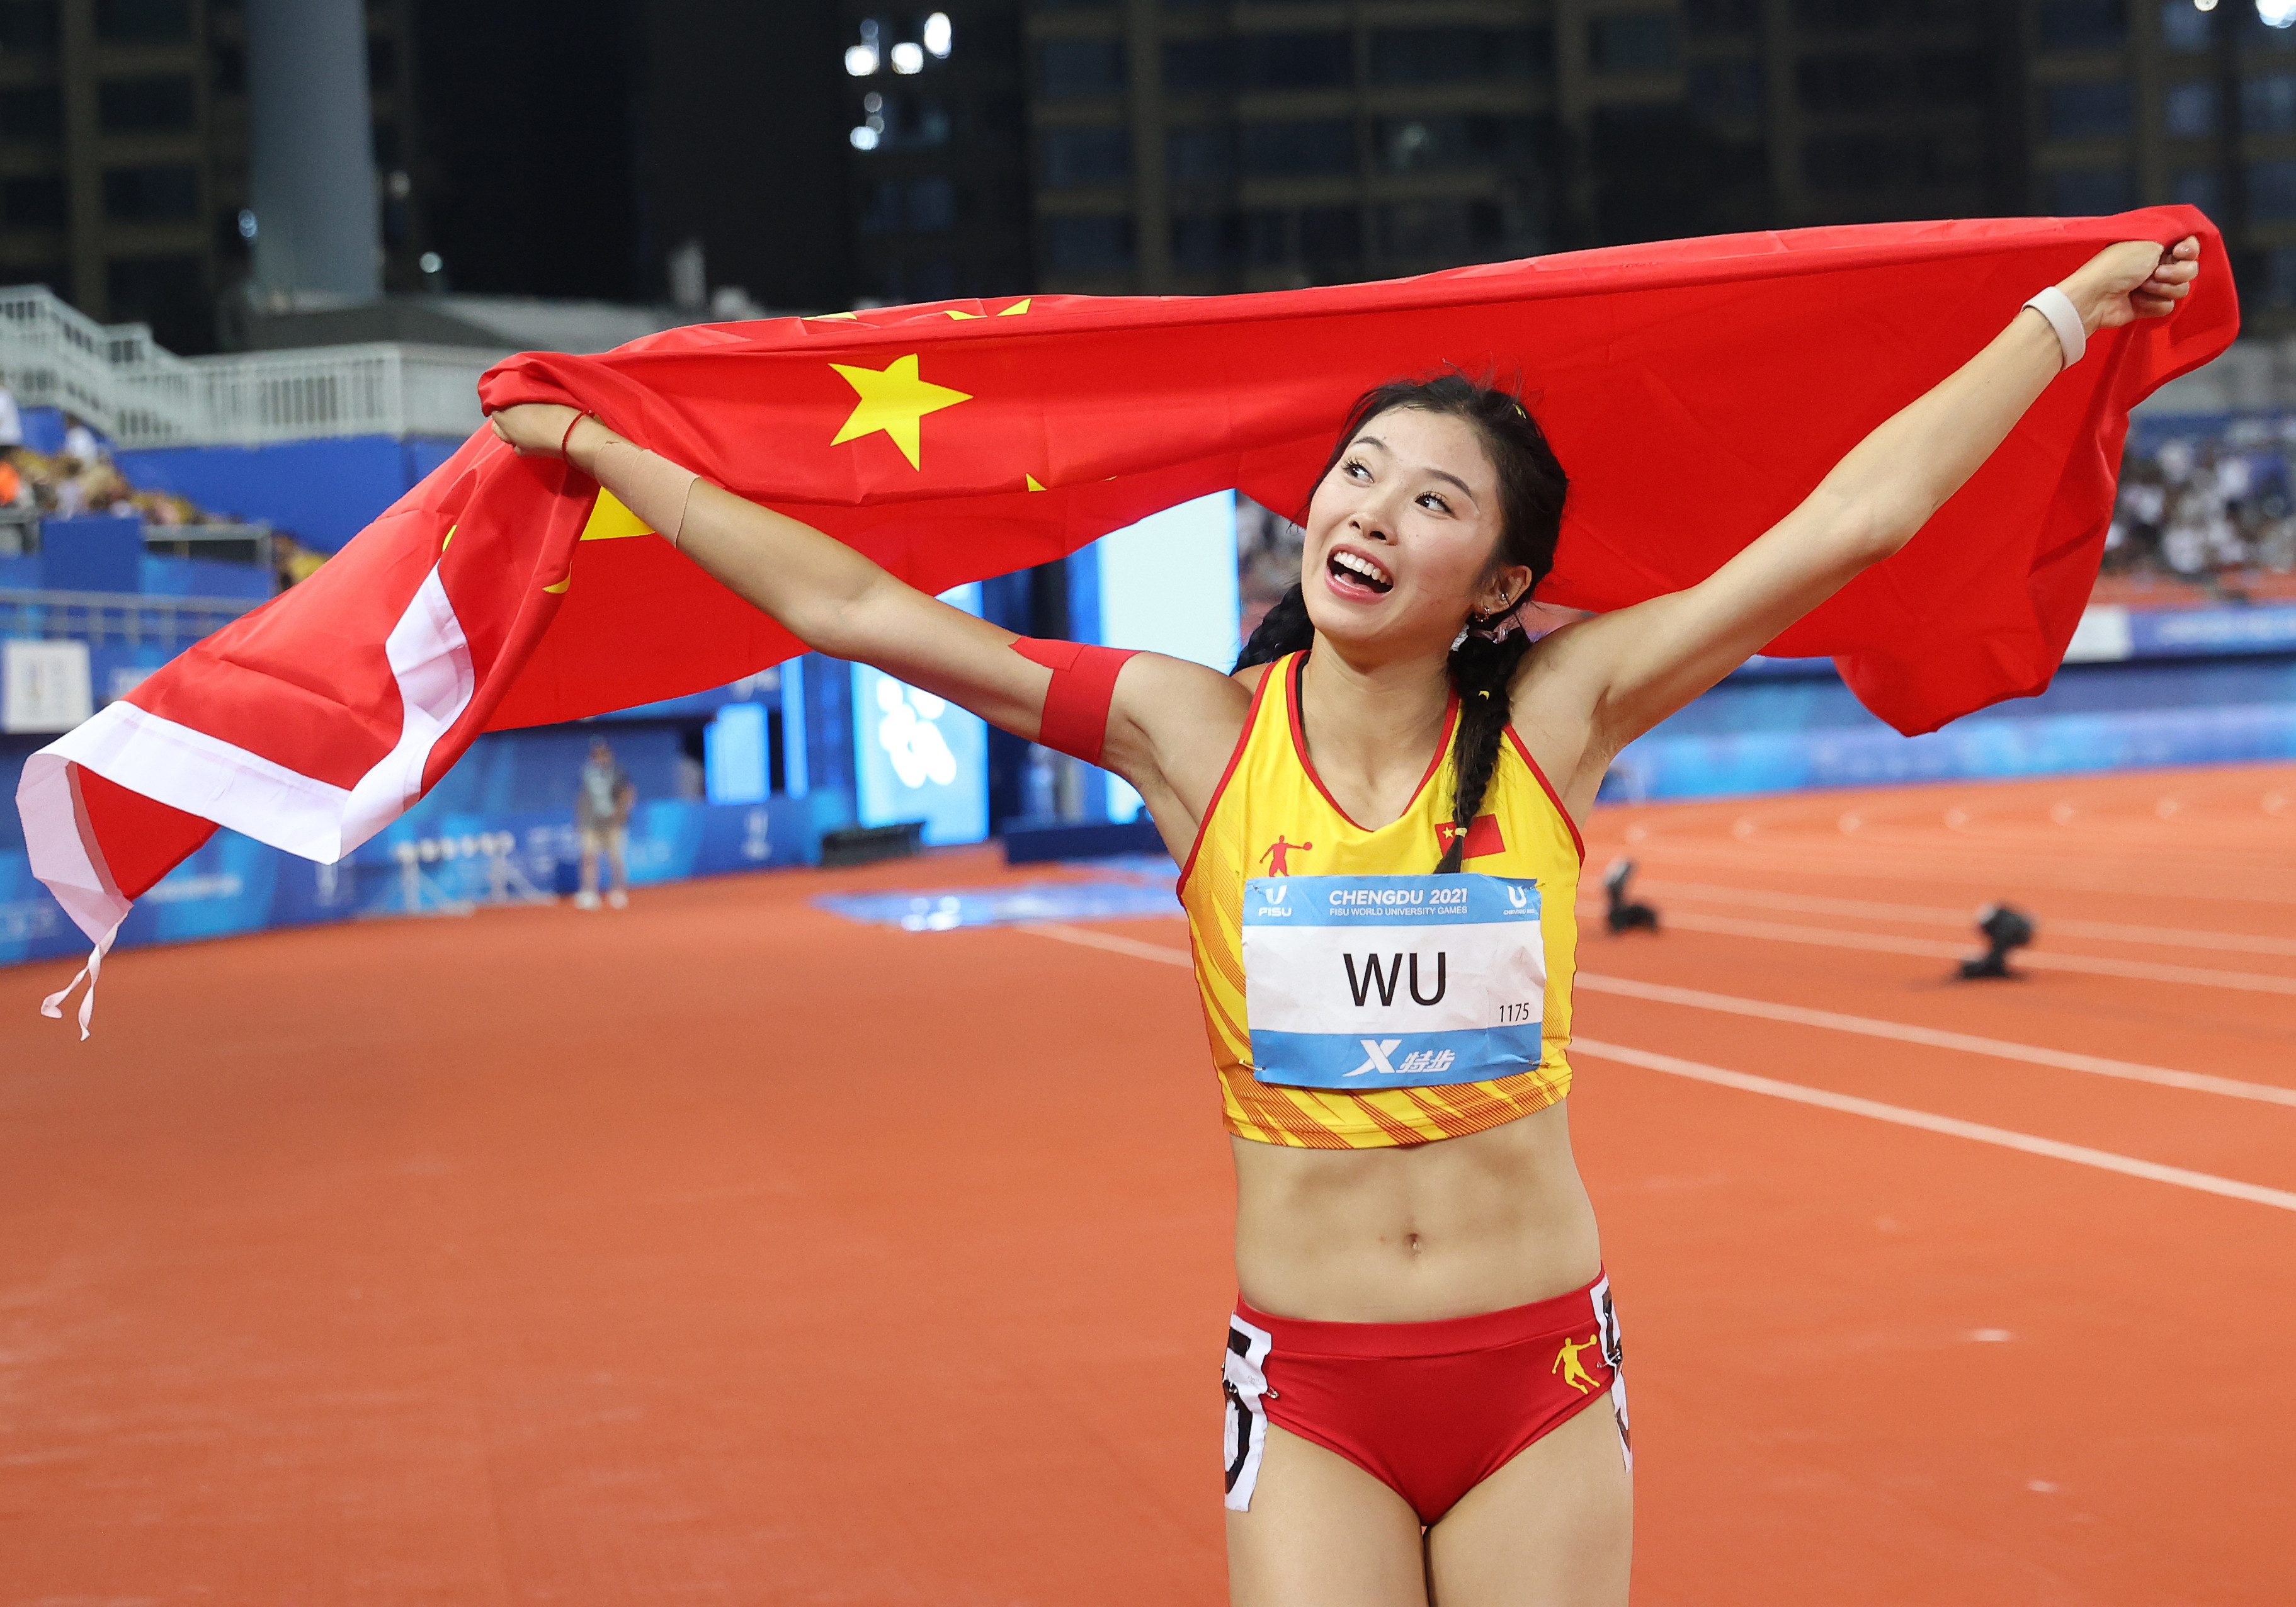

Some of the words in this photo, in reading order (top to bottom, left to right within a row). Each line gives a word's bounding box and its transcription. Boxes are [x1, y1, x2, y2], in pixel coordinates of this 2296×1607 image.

[1329, 889, 1424, 906] CHENGDU
[1429, 888, 1468, 904] 2021
[1258, 907, 1292, 917] FISU
[1329, 907, 1350, 916] FISU
[1351, 907, 1383, 916] WORLD
[1385, 907, 1436, 916] UNIVERSITY
[1437, 906, 1468, 915] GAMES
[1343, 951, 1446, 1007] WU
[1499, 1002, 1530, 1023] 1175
[1395, 1049, 1455, 1074] 特步
